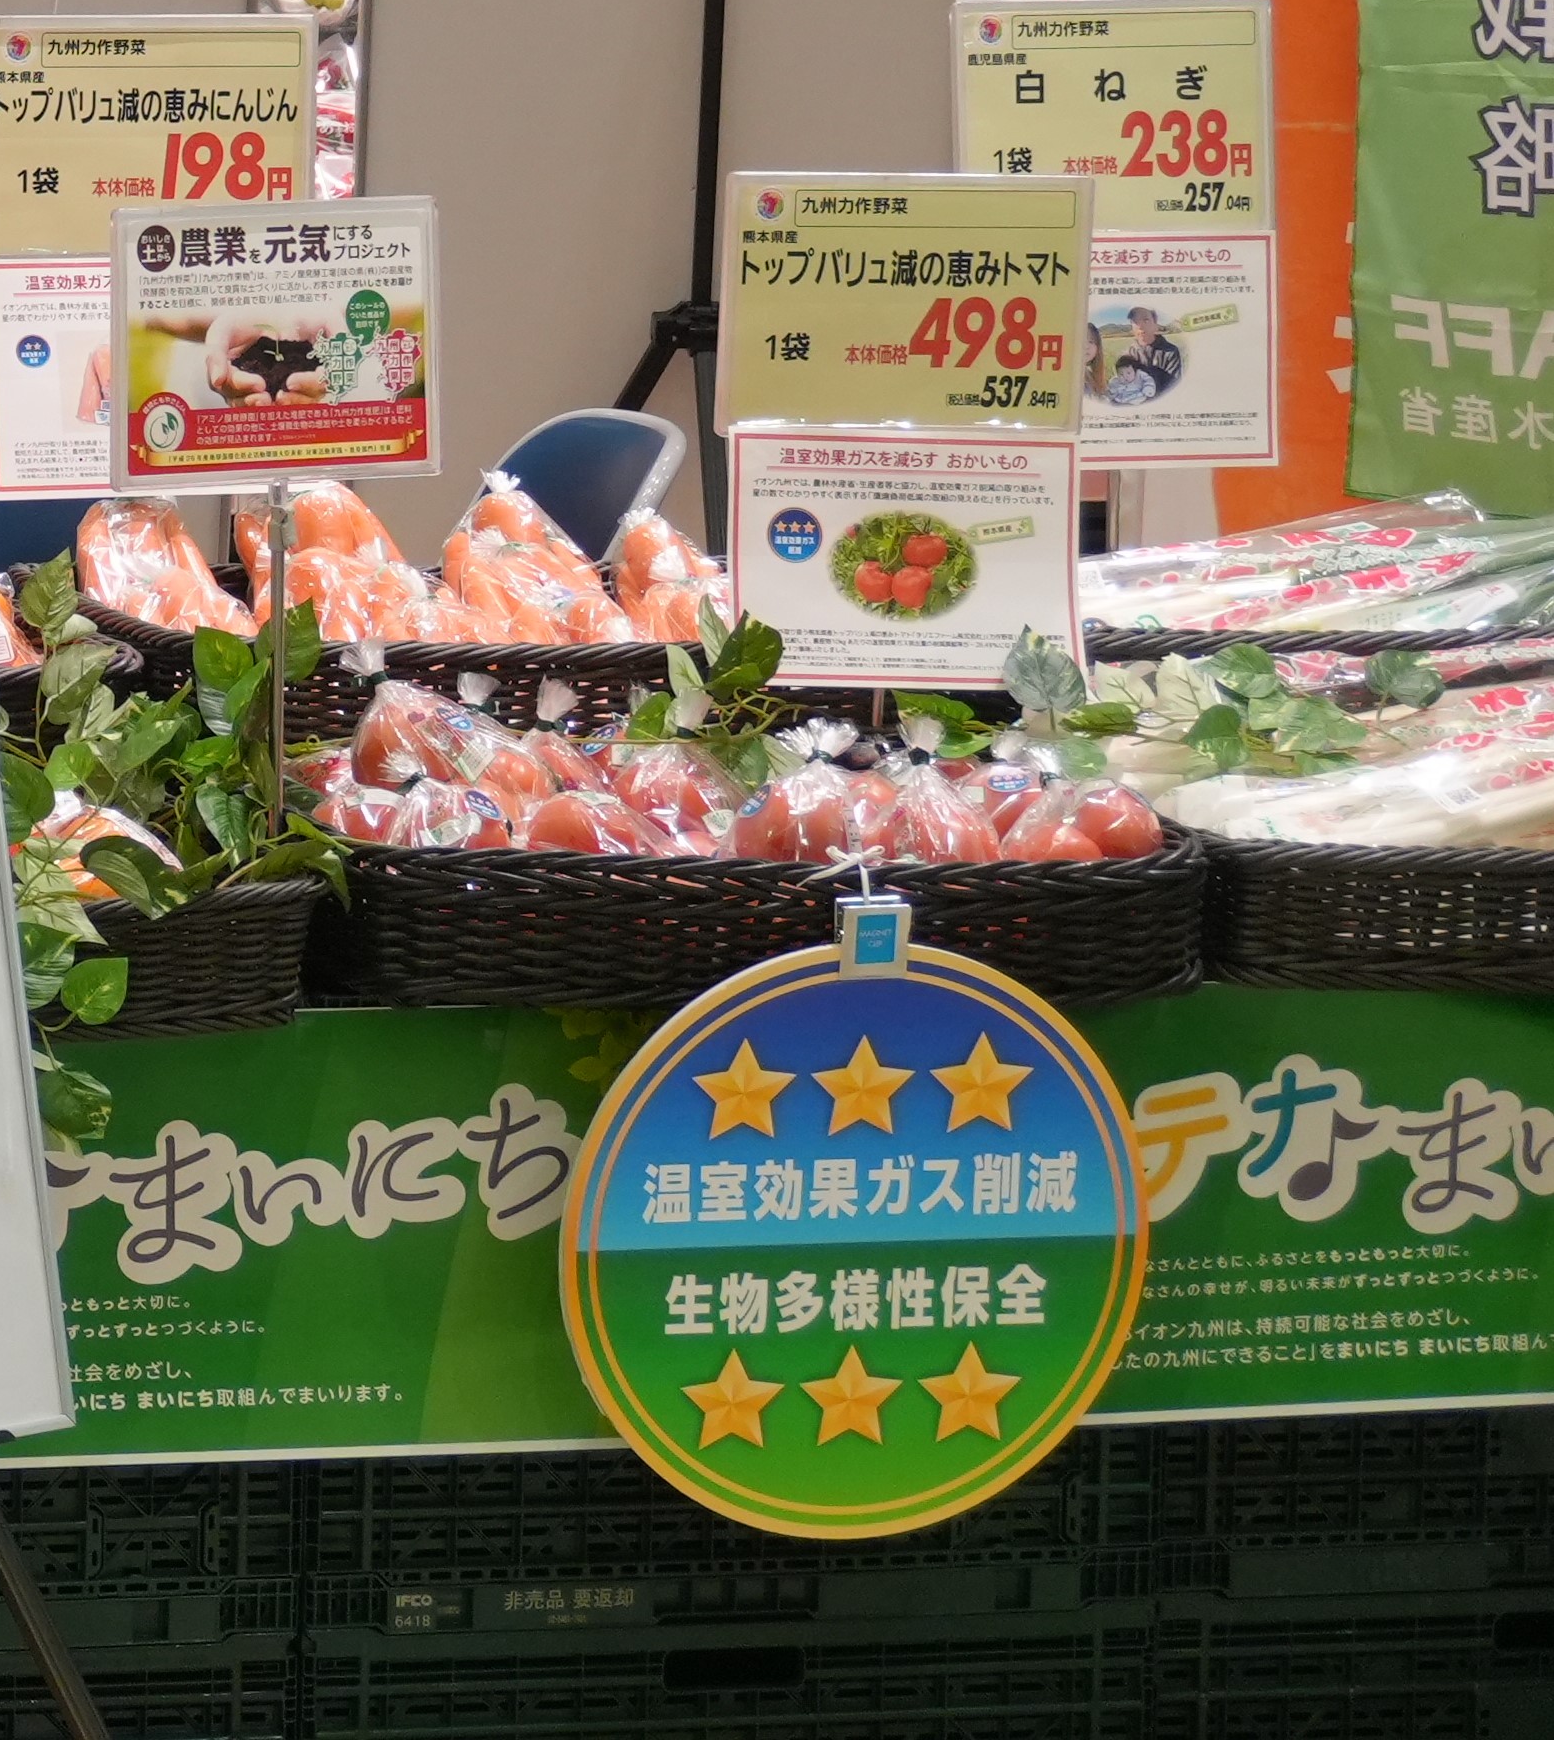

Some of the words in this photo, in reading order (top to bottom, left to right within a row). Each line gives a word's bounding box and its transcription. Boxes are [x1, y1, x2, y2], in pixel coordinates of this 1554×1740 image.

[1017, 20, 1110, 38] 九州力作野菜
[47, 36, 147, 58] 九州力作野菜
[966, 52, 1028, 66] 鹿児島県産
[1061, 155, 1118, 177] 本体価格
[1119, 108, 1253, 178] 238円
[91, 175, 155, 199] 本体価格
[160, 131, 293, 202] 198円
[993, 147, 1033, 173] 1袋
[17, 167, 60, 195] 1袋
[801, 196, 909, 216] 九州力作野菜
[332, 224, 373, 241] にする
[742, 230, 799, 245] 熊本県産
[333, 242, 412, 261] プロジェクト
[1160, 248, 1232, 264] おかいもの
[740, 249, 1072, 288] トップバリュ減の恵みトマト
[844, 343, 908, 366] 本体価格
[907, 296, 1064, 372] 498円
[765, 332, 811, 361] 1袋
[779, 447, 939, 469] 温室効果ガスを減らす
[946, 451, 1029, 471] おかいもの
[108, 1096, 570, 1264] まいにち
[641, 1148, 1077, 1226] 温室効果ガス削減
[663, 1264, 1048, 1337] 生物多様性保全
[395, 1593, 433, 1608] IFCO
[503, 1589, 565, 1612] 非売品
[572, 1587, 635, 1610] 要返却
[394, 1614, 432, 1629] 6418
